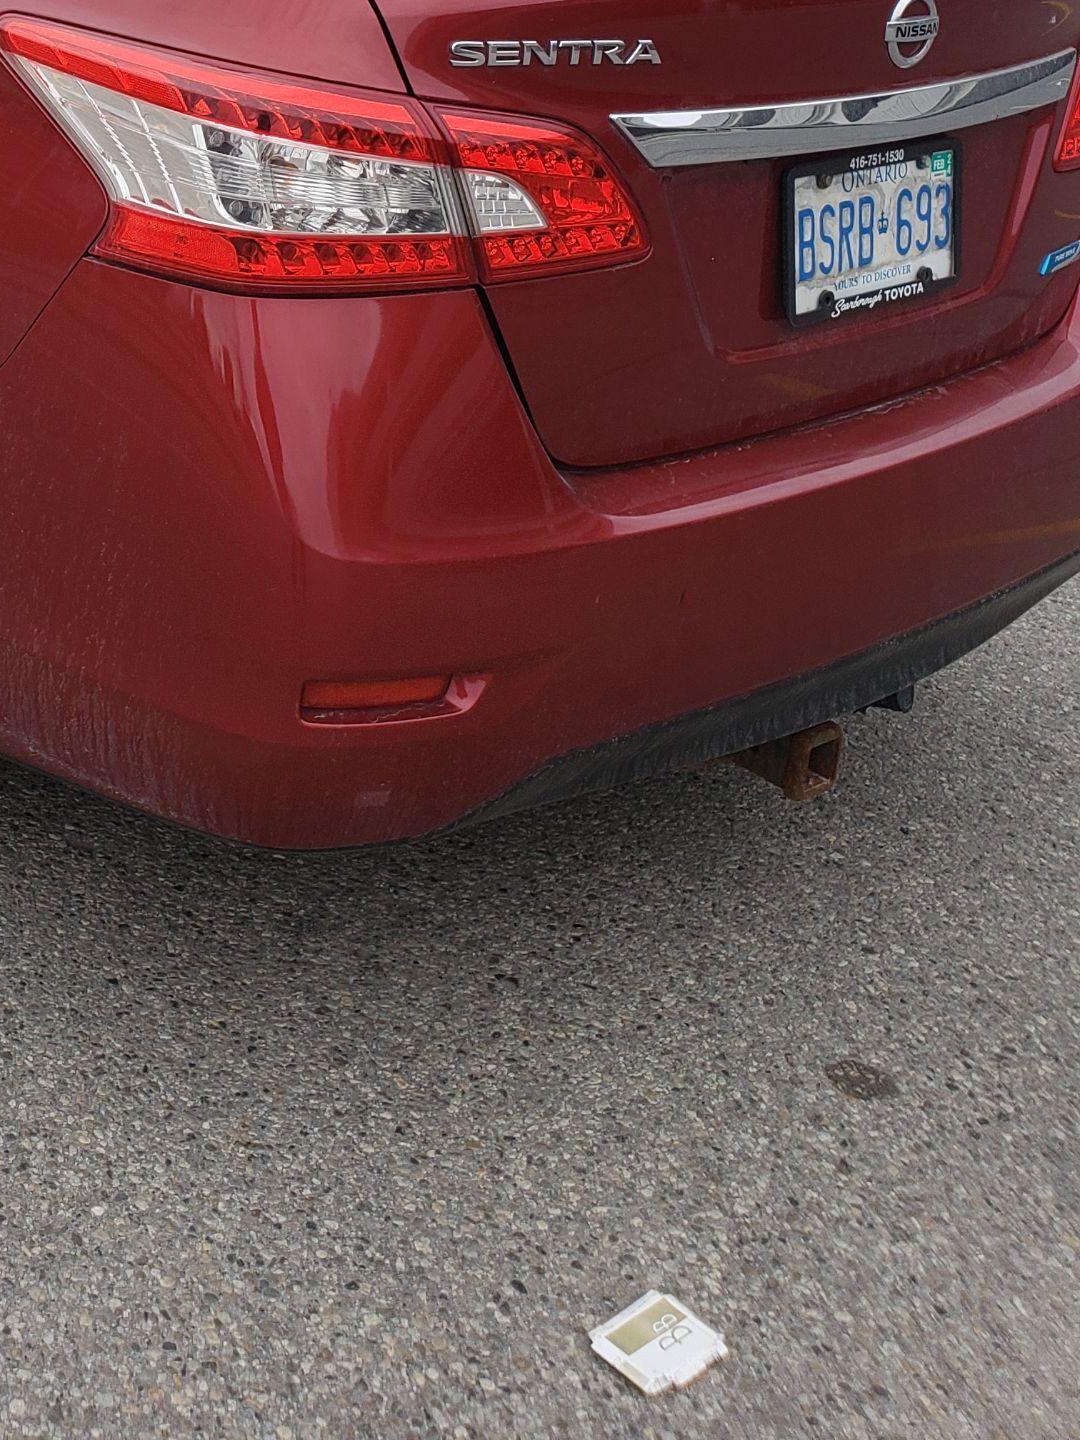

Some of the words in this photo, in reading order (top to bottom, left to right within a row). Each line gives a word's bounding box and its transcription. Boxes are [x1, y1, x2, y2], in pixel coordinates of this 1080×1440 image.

[895, 21, 938, 38] NISSAN
[450, 39, 662, 67] SENTRA
[849, 149, 905, 170] 416-751-1530
[933, 158, 945, 171] FEB
[841, 162, 908, 193] ONTARIO
[797, 195, 875, 282] BSRB
[896, 181, 951, 256] 693
[833, 275, 859, 291] YOURS
[862, 274, 873, 285] TO
[874, 264, 912, 281] DISCOVER
[831, 288, 884, 318] Scarborough
[884, 282, 924, 302] TOYOTA
